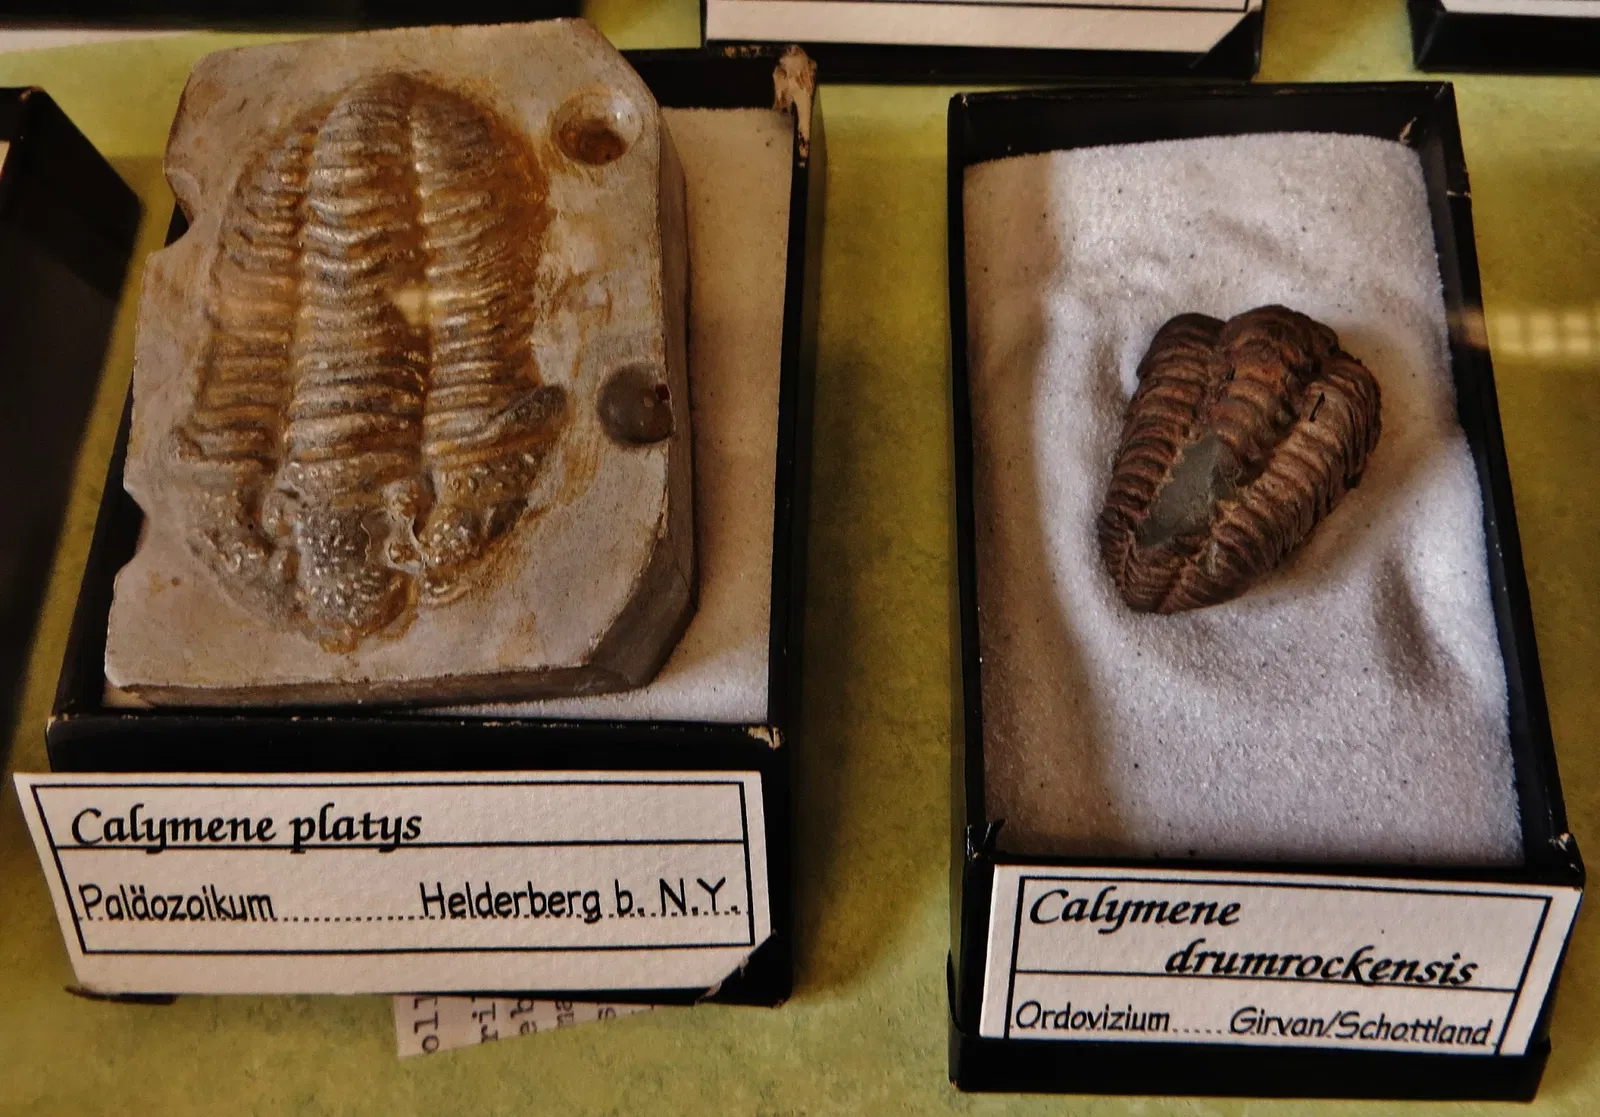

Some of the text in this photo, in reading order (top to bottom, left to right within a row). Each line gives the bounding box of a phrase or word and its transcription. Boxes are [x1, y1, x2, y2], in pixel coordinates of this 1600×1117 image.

[71, 803, 423, 854] Calymene platys
[419, 880, 601, 924] Helderberg
[1029, 886, 1242, 934] Calymene
[1164, 938, 1479, 986] drumrockensis
[1015, 1000, 1171, 1033] Ordovizium
